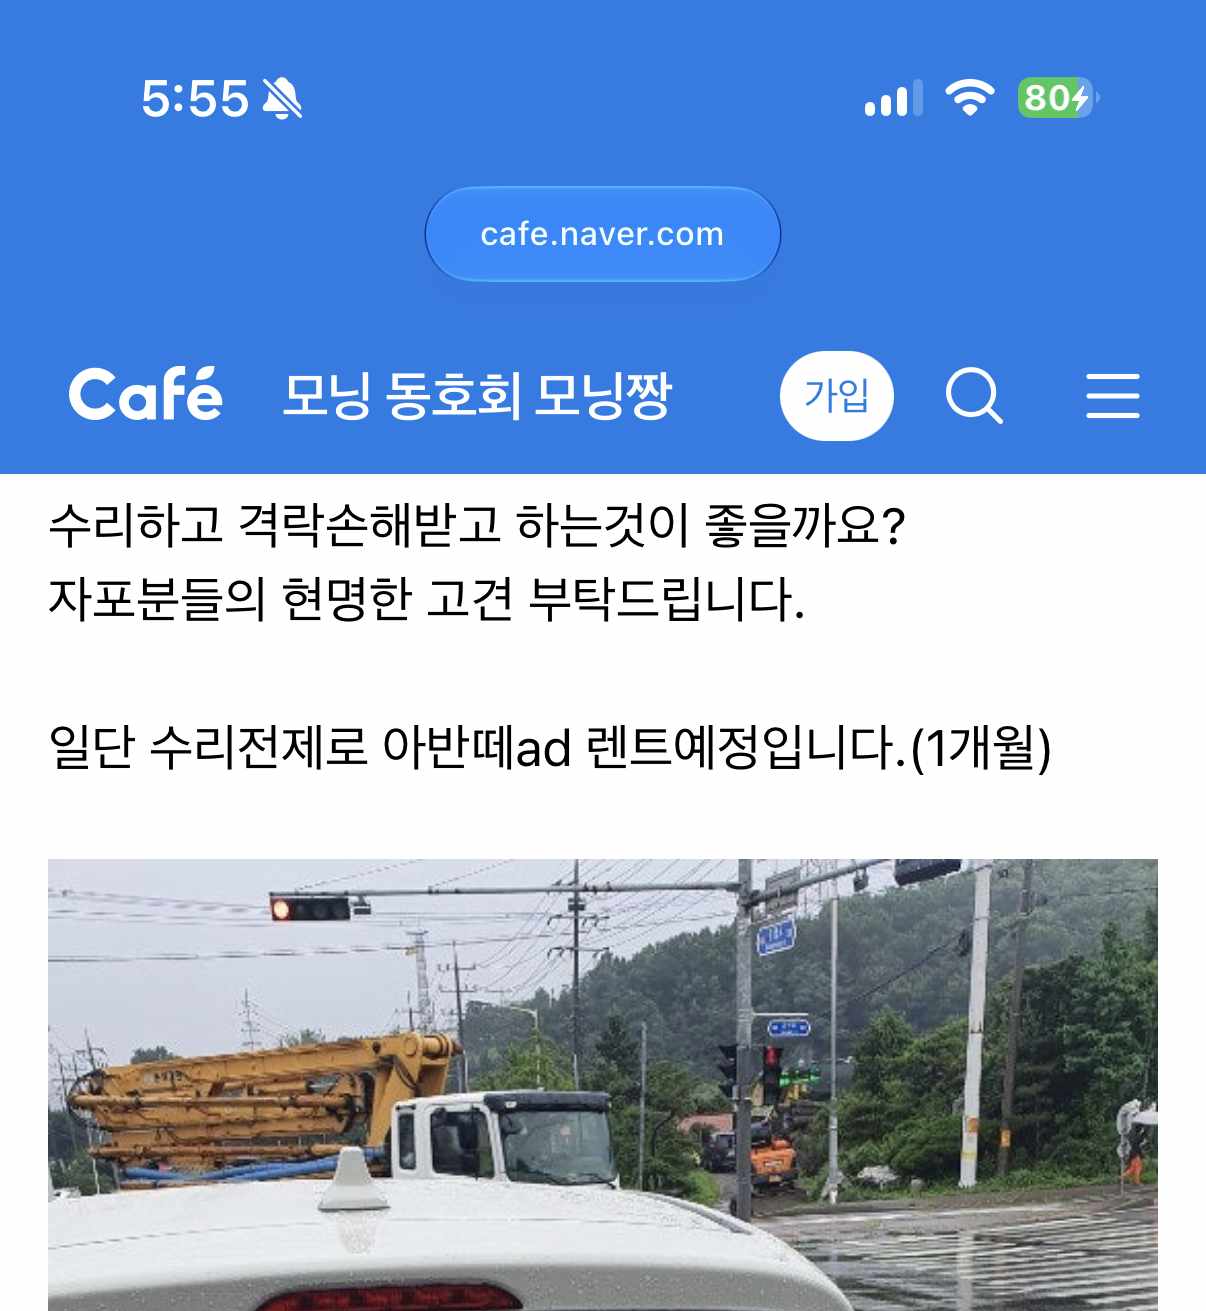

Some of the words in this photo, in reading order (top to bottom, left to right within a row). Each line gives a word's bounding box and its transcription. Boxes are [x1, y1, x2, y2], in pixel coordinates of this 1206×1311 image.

[143, 80, 248, 117] 5:55
[1024, 84, 1071, 112] 80
[481, 219, 723, 246] cafe.naver.com
[69, 366, 223, 420] Café
[283, 372, 369, 420] 모닝
[386, 372, 519, 421] 동호회
[535, 372, 672, 420] 모닝짱
[804, 377, 869, 414] 가입
[50, 503, 223, 548] 수리하고
[240, 503, 501, 548] 격락손해받고
[516, 503, 686, 548] 하는것이
[706, 502, 905, 548] 좋을까요?
[49, 577, 263, 622] 자포분들의
[283, 576, 412, 622] 현명한
[428, 577, 511, 621] 고견
[530, 577, 803, 622] 부탁드립니다.
[51, 725, 135, 769] 일단
[151, 725, 368, 770] 수리전제로
[384, 725, 569, 770] 아반떼ad
[588, 724, 1050, 776] 렌트예정입니다.(1개월)
